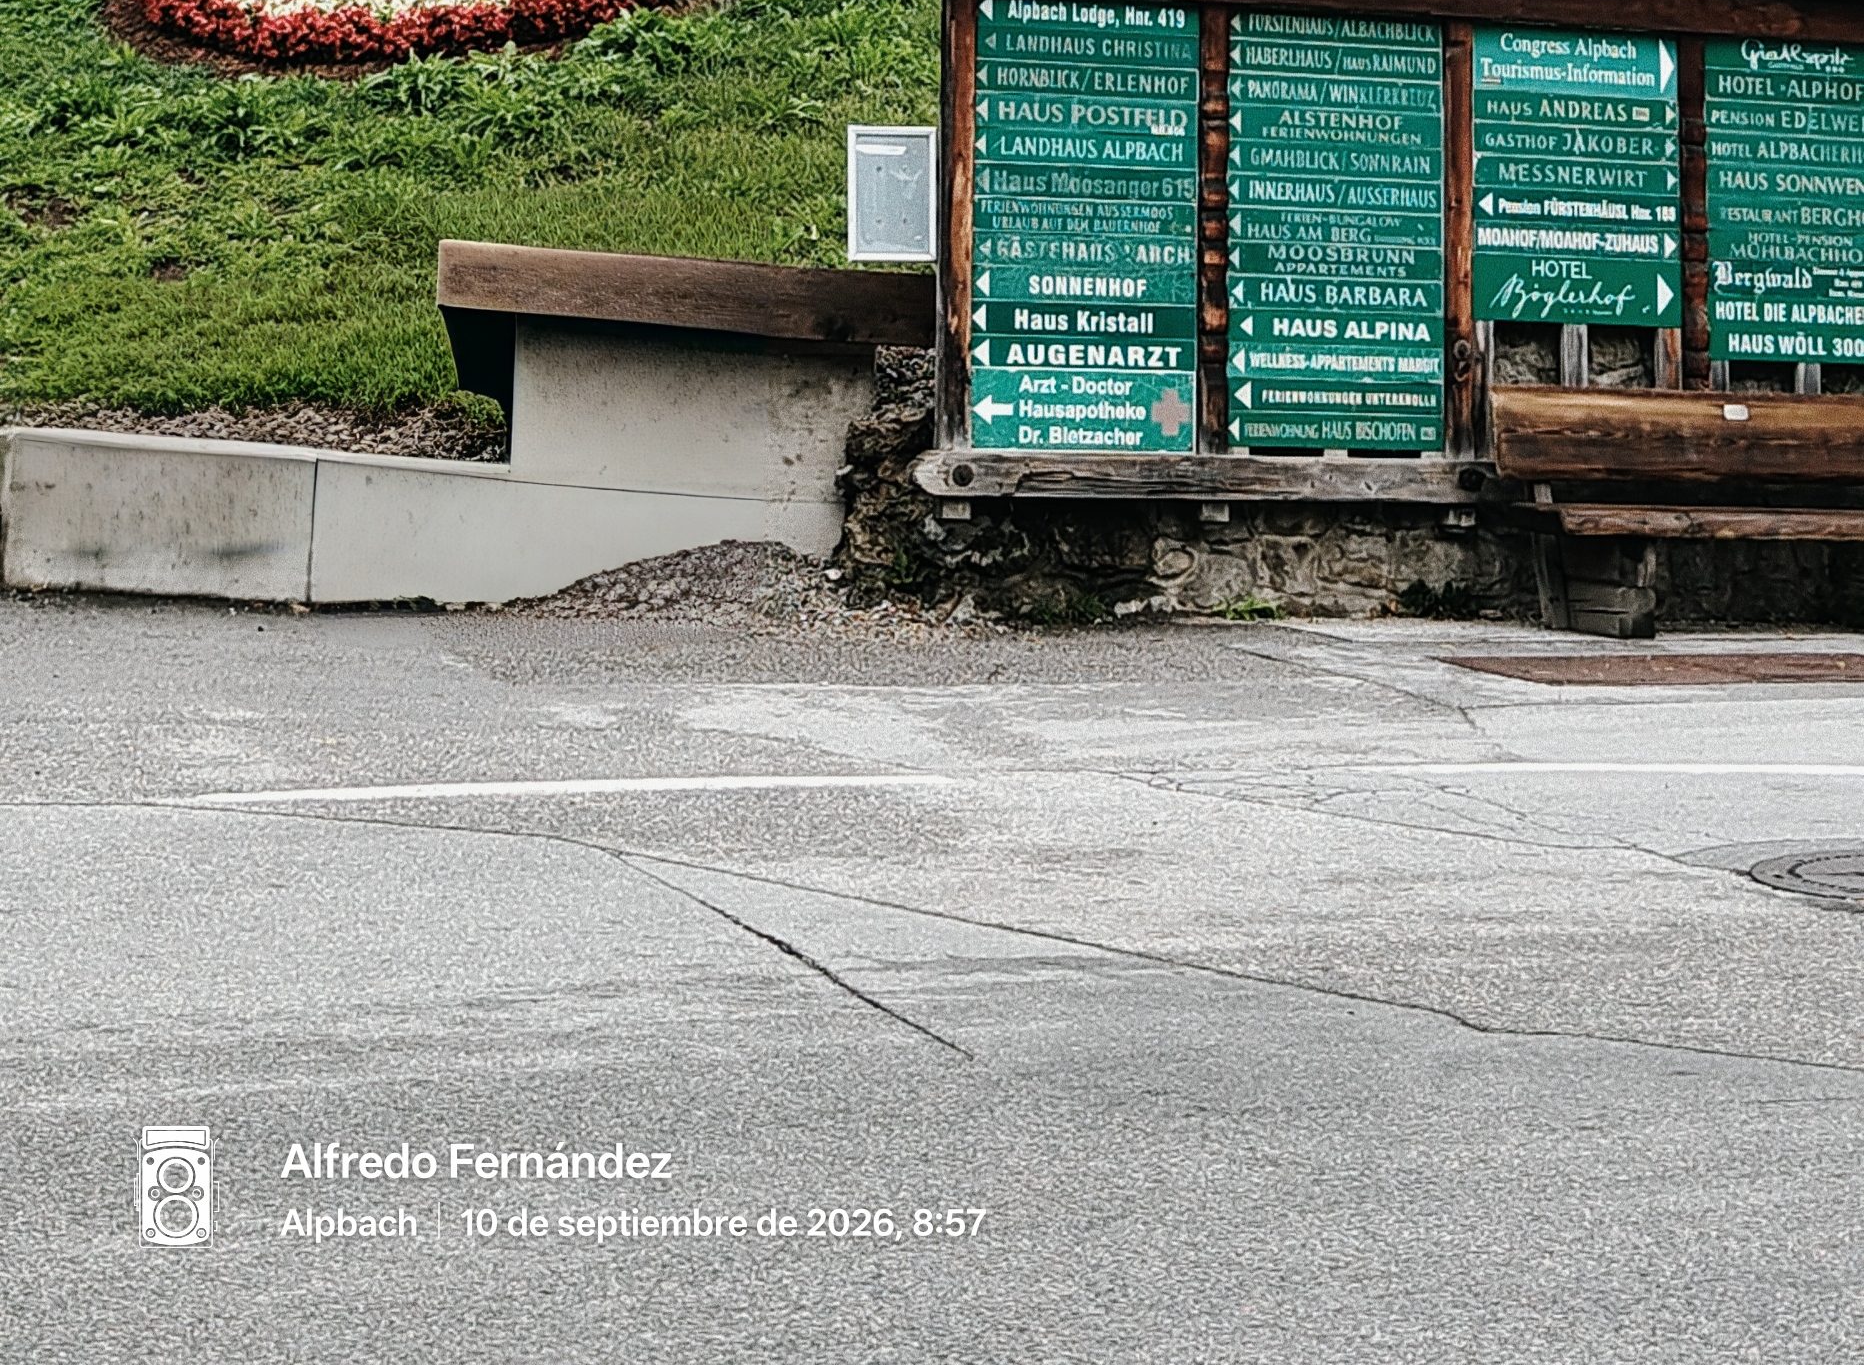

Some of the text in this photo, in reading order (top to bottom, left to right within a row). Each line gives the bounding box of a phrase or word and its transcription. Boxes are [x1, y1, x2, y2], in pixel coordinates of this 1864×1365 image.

[1008, 0, 1185, 28] Alpbach Lodge, Hnr. 419
[1006, 34, 1193, 60] LANDHAUS CHRISTINA
[1500, 33, 1637, 62] Congress Alpbach
[1481, 58, 1655, 87] Tourismus-Information
[1718, 75, 1864, 101] HOTEL ALPHOF
[998, 101, 1187, 128] HAUS POSTFELD
[1279, 110, 1403, 131] ALSTENHOF
[1487, 100, 1532, 117] HAUS
[1539, 98, 1627, 122] ANDREAS
[1711, 110, 1775, 127] PENSION
[1262, 127, 1422, 144] FERIENWOHNUNGEN
[1485, 132, 1654, 155] GASTHOF JAKOBER
[1000, 136, 1183, 161] LANDHAUS ALPBACH
[1712, 141, 1864, 163] HOTEL ALPBACHERH
[993, 170, 1048, 191] Haus
[1162, 178, 1194, 197] 615
[1499, 163, 1647, 187] MESSNERWIRT
[1719, 171, 1769, 191] HAUS
[1498, 198, 1541, 215] Pension
[1800, 207, 1864, 226] BERGH
[992, 216, 1038, 229] URLAUB
[1040, 219, 1064, 230] AUF
[1247, 224, 1291, 240] HAUS
[1297, 227, 1322, 241] AM
[1331, 228, 1371, 242] BERG
[1268, 245, 1415, 264] MOOSBRUNN
[1274, 262, 1406, 277] APPARTEMENTS
[1531, 260, 1593, 279] HOTEL
[1712, 261, 1813, 293] Bergwald
[1028, 276, 1147, 298] SONNENHOF
[1260, 283, 1428, 307] HAUS BARBARA
[1014, 309, 1154, 333] Haus Kristall
[1716, 301, 1759, 321] HOTEL
[1764, 303, 1786, 322] DIE
[1273, 318, 1431, 342] HAUS ALPINA
[1006, 344, 1182, 367] AUGENARZT
[1728, 332, 1864, 357] HAUS WÖLL 300
[1019, 375, 1057, 393] Arzt
[1072, 377, 1133, 394] Doctor
[1019, 400, 1146, 421] Hausapotheke
[1018, 427, 1043, 444] Dr.
[1322, 421, 1351, 439] HAUS
[1355, 423, 1416, 441] BISCHOFEN
